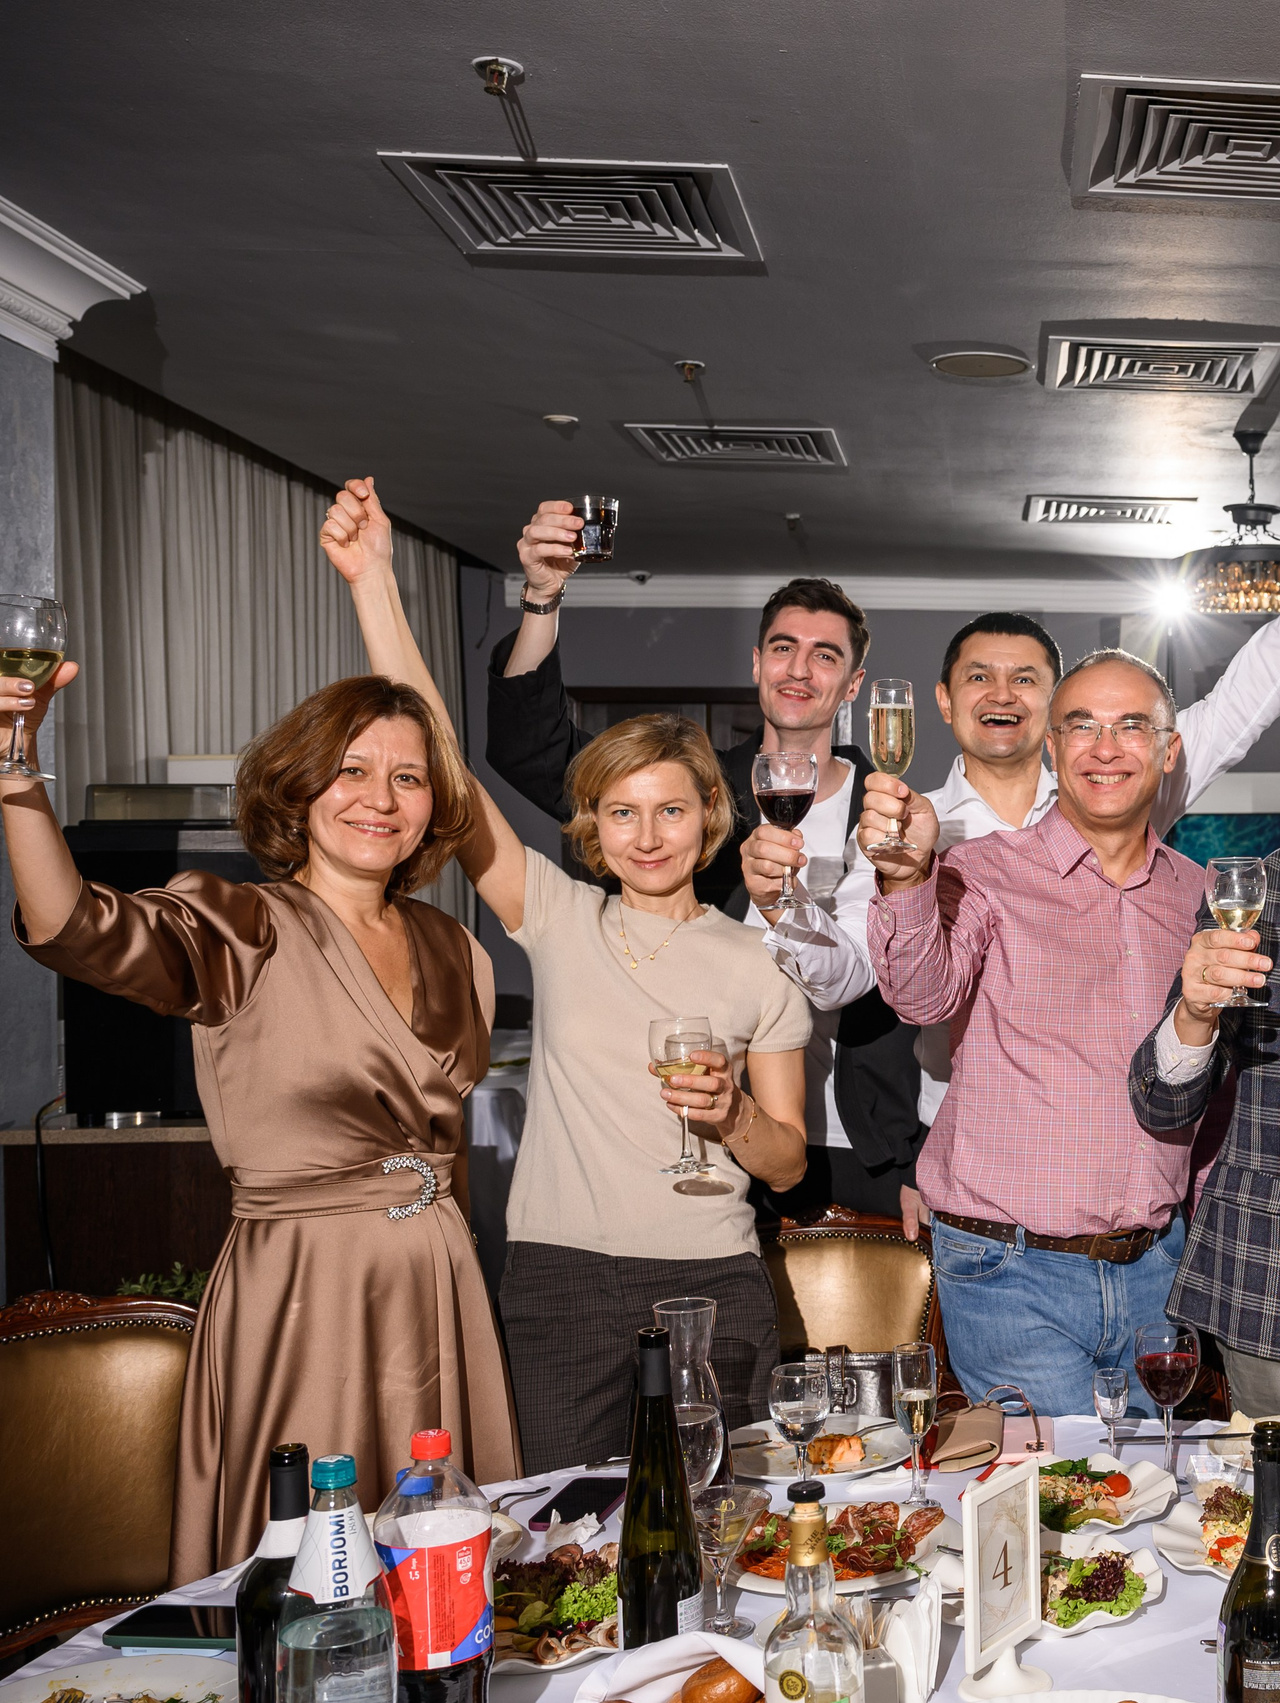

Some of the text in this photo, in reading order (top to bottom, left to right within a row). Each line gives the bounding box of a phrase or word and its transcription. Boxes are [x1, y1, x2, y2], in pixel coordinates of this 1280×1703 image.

[803, 1530, 819, 1545] THE
[329, 1513, 349, 1598] BORJOMI
[992, 1540, 1013, 1591] 4
[409, 1571, 420, 1581] 1,5
